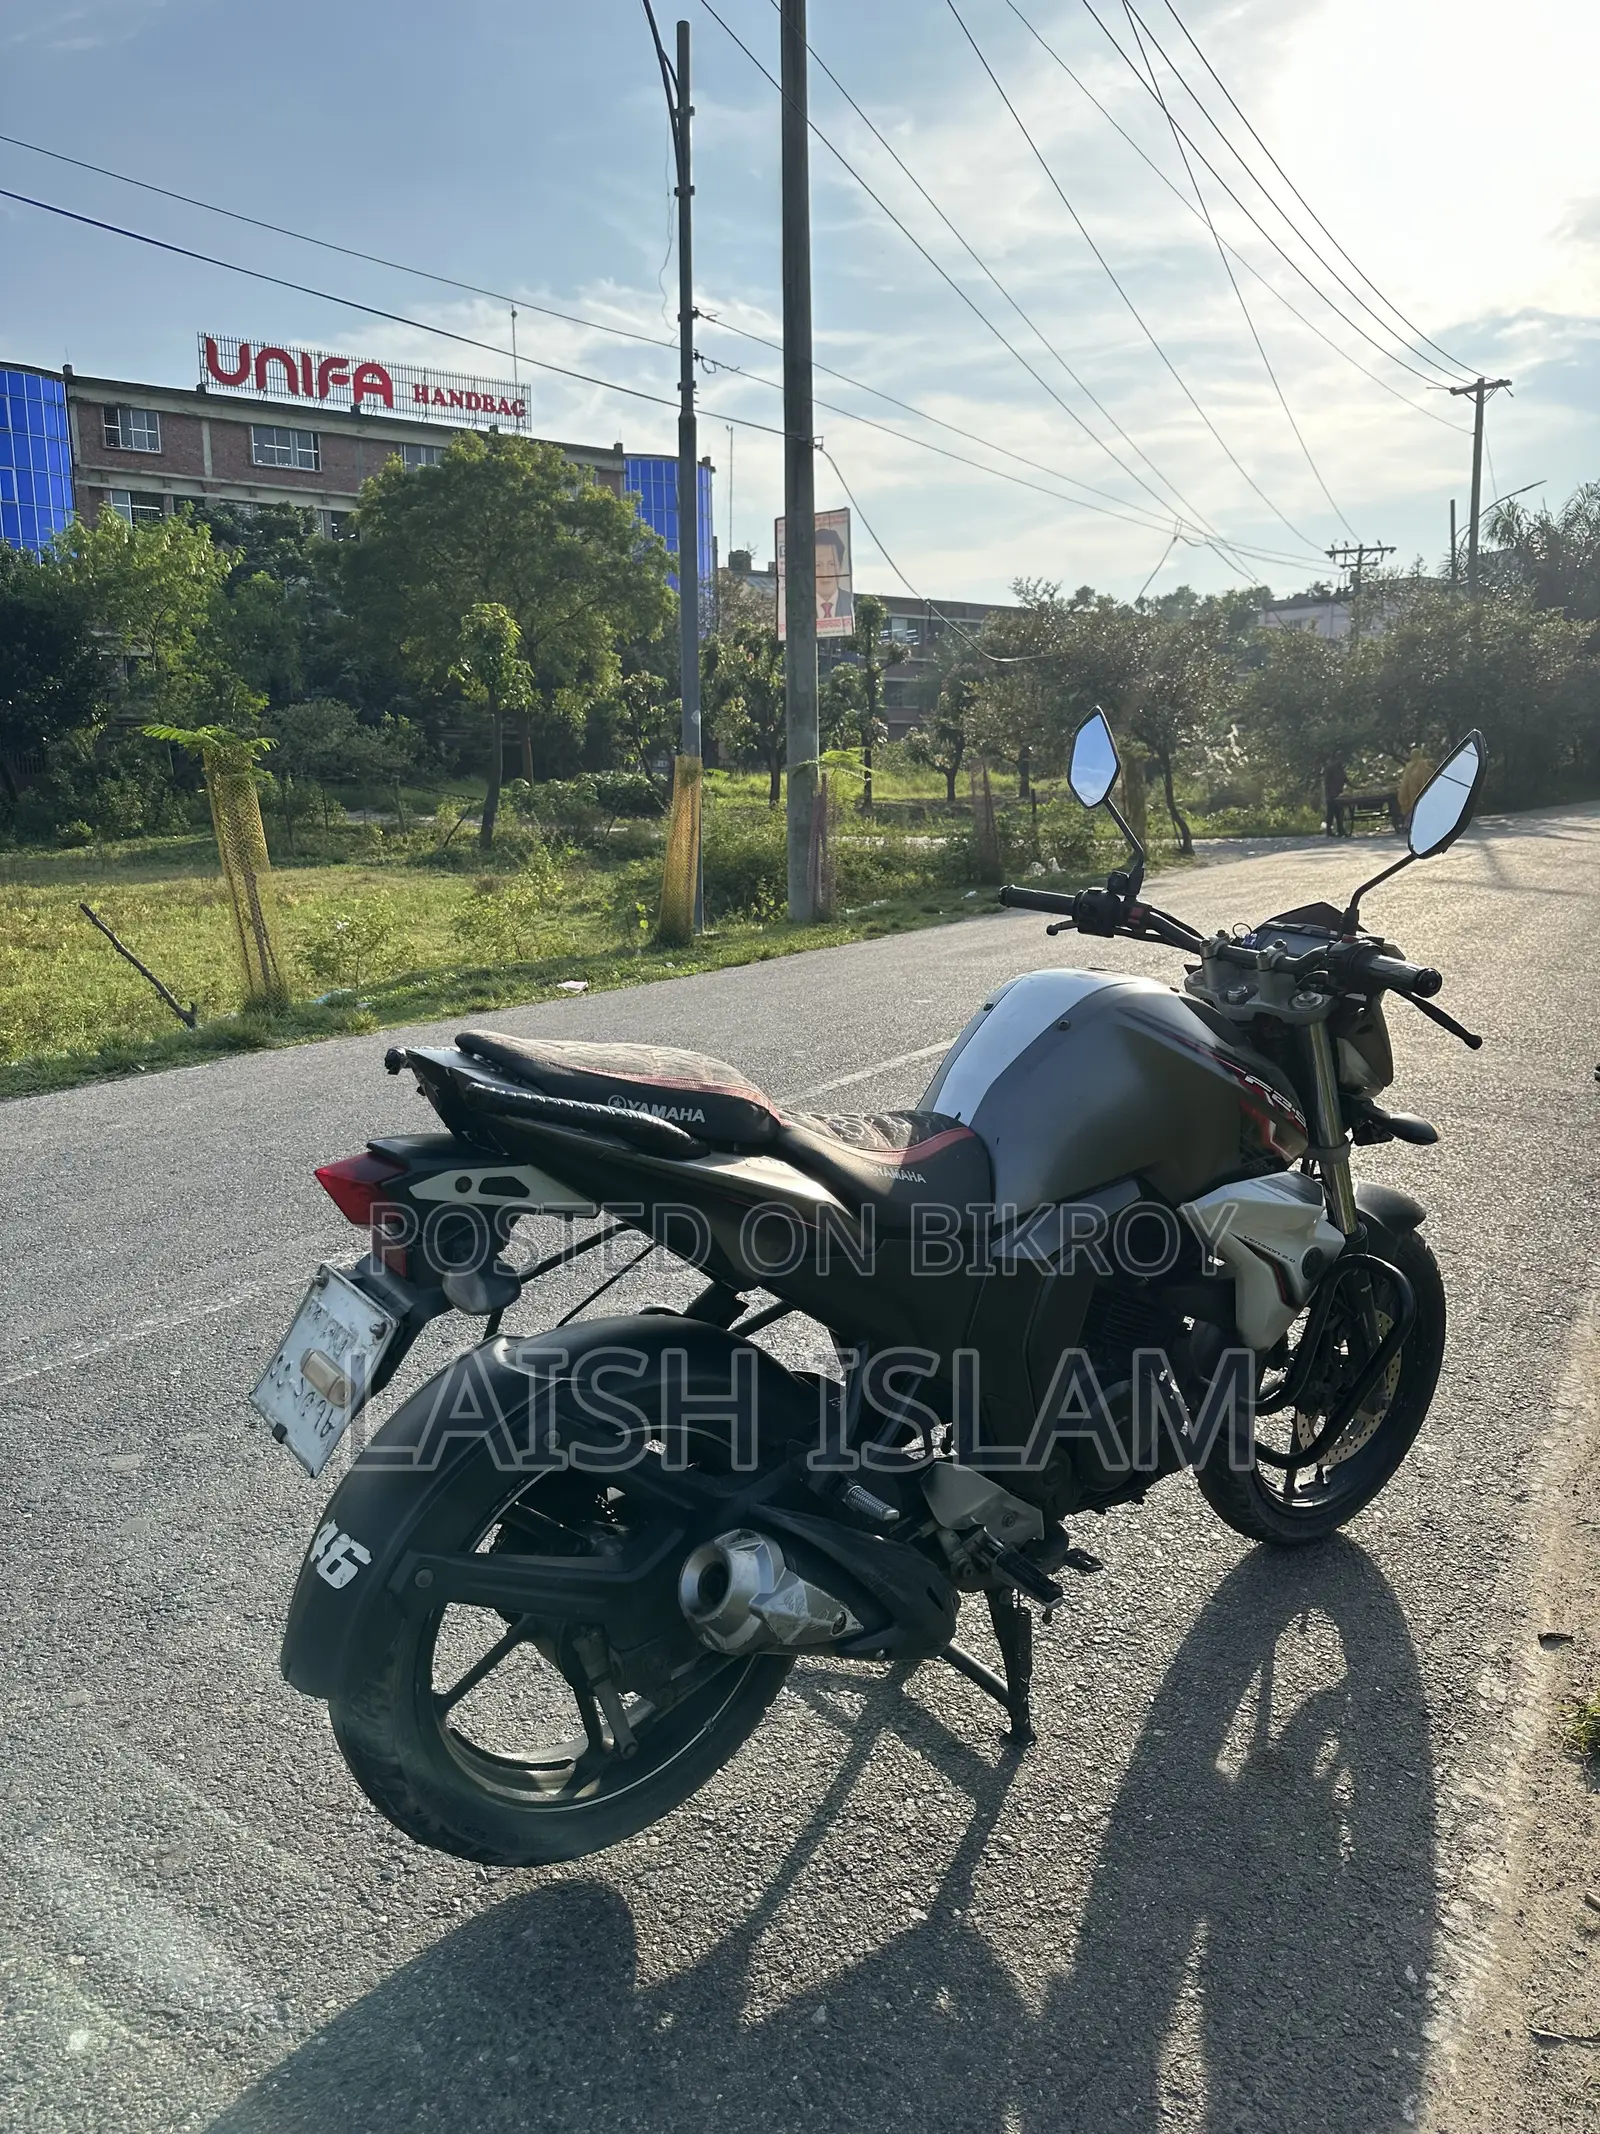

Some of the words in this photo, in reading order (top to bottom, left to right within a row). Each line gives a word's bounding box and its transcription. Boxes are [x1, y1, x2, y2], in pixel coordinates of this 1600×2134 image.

[205, 337, 394, 409] UNIFA
[412, 384, 528, 418] HANDBAG
[626, 1099, 706, 1123] YAMAHA
[876, 1165, 927, 1184] YAMAHA
